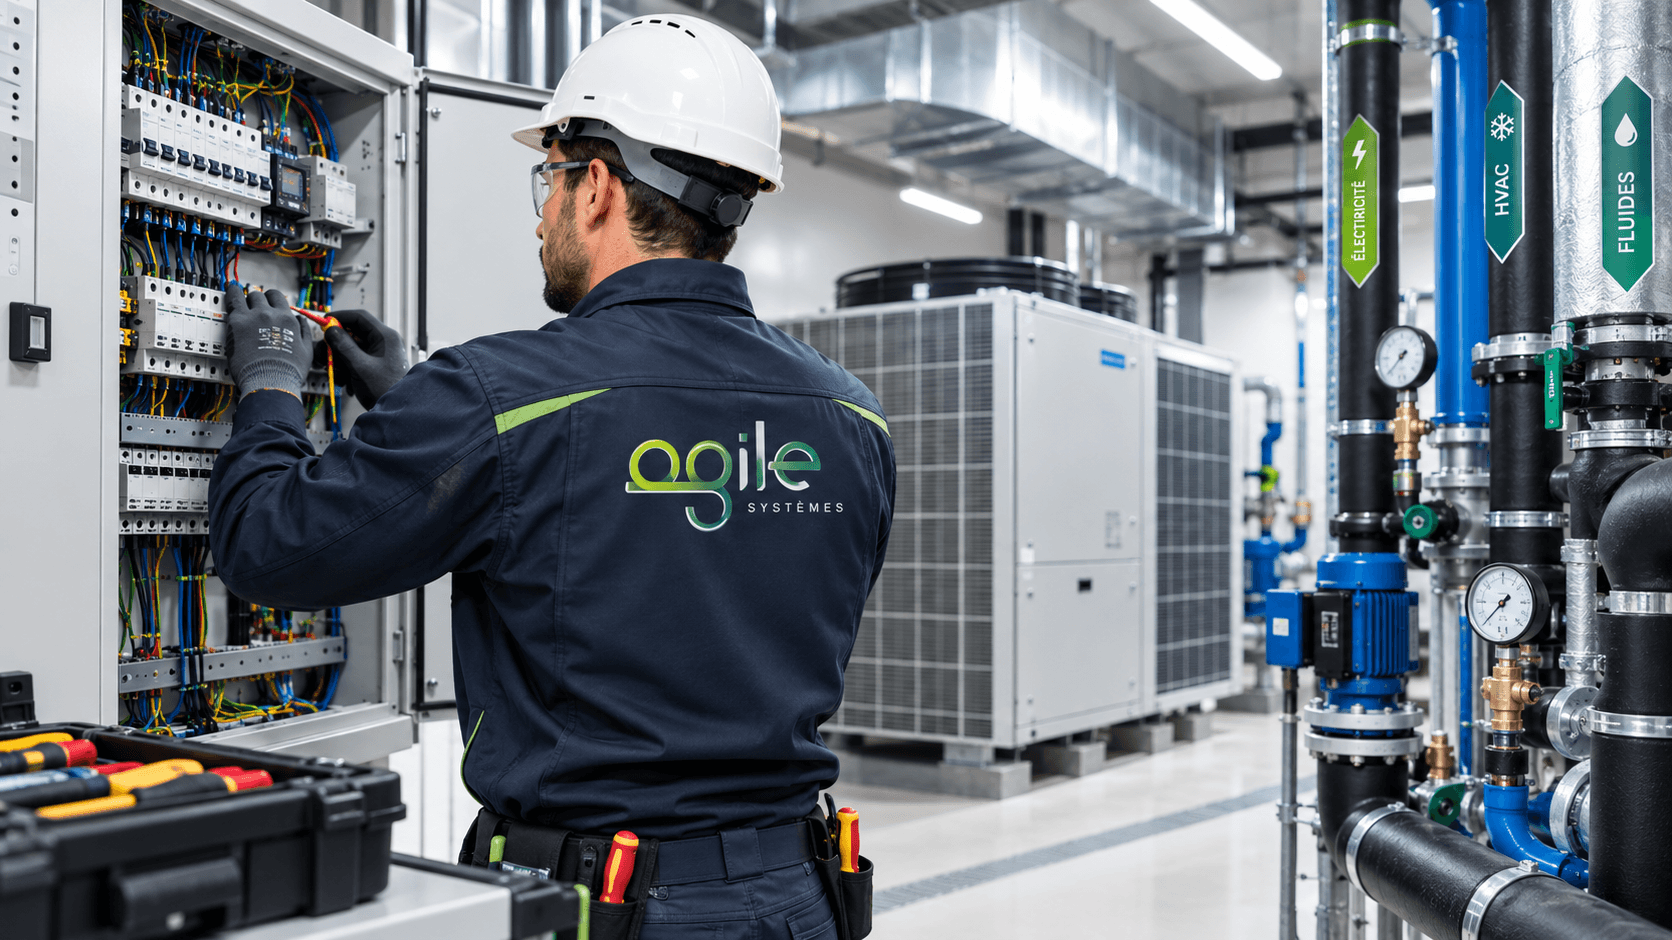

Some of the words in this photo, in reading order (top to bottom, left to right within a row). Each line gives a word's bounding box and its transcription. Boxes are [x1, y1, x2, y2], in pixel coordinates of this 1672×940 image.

[1495, 163, 1509, 216] HVAC
[1618, 171, 1635, 253] FLUIDES
[625, 420, 821, 532] agile
[747, 500, 844, 513] SYSTÈMES
